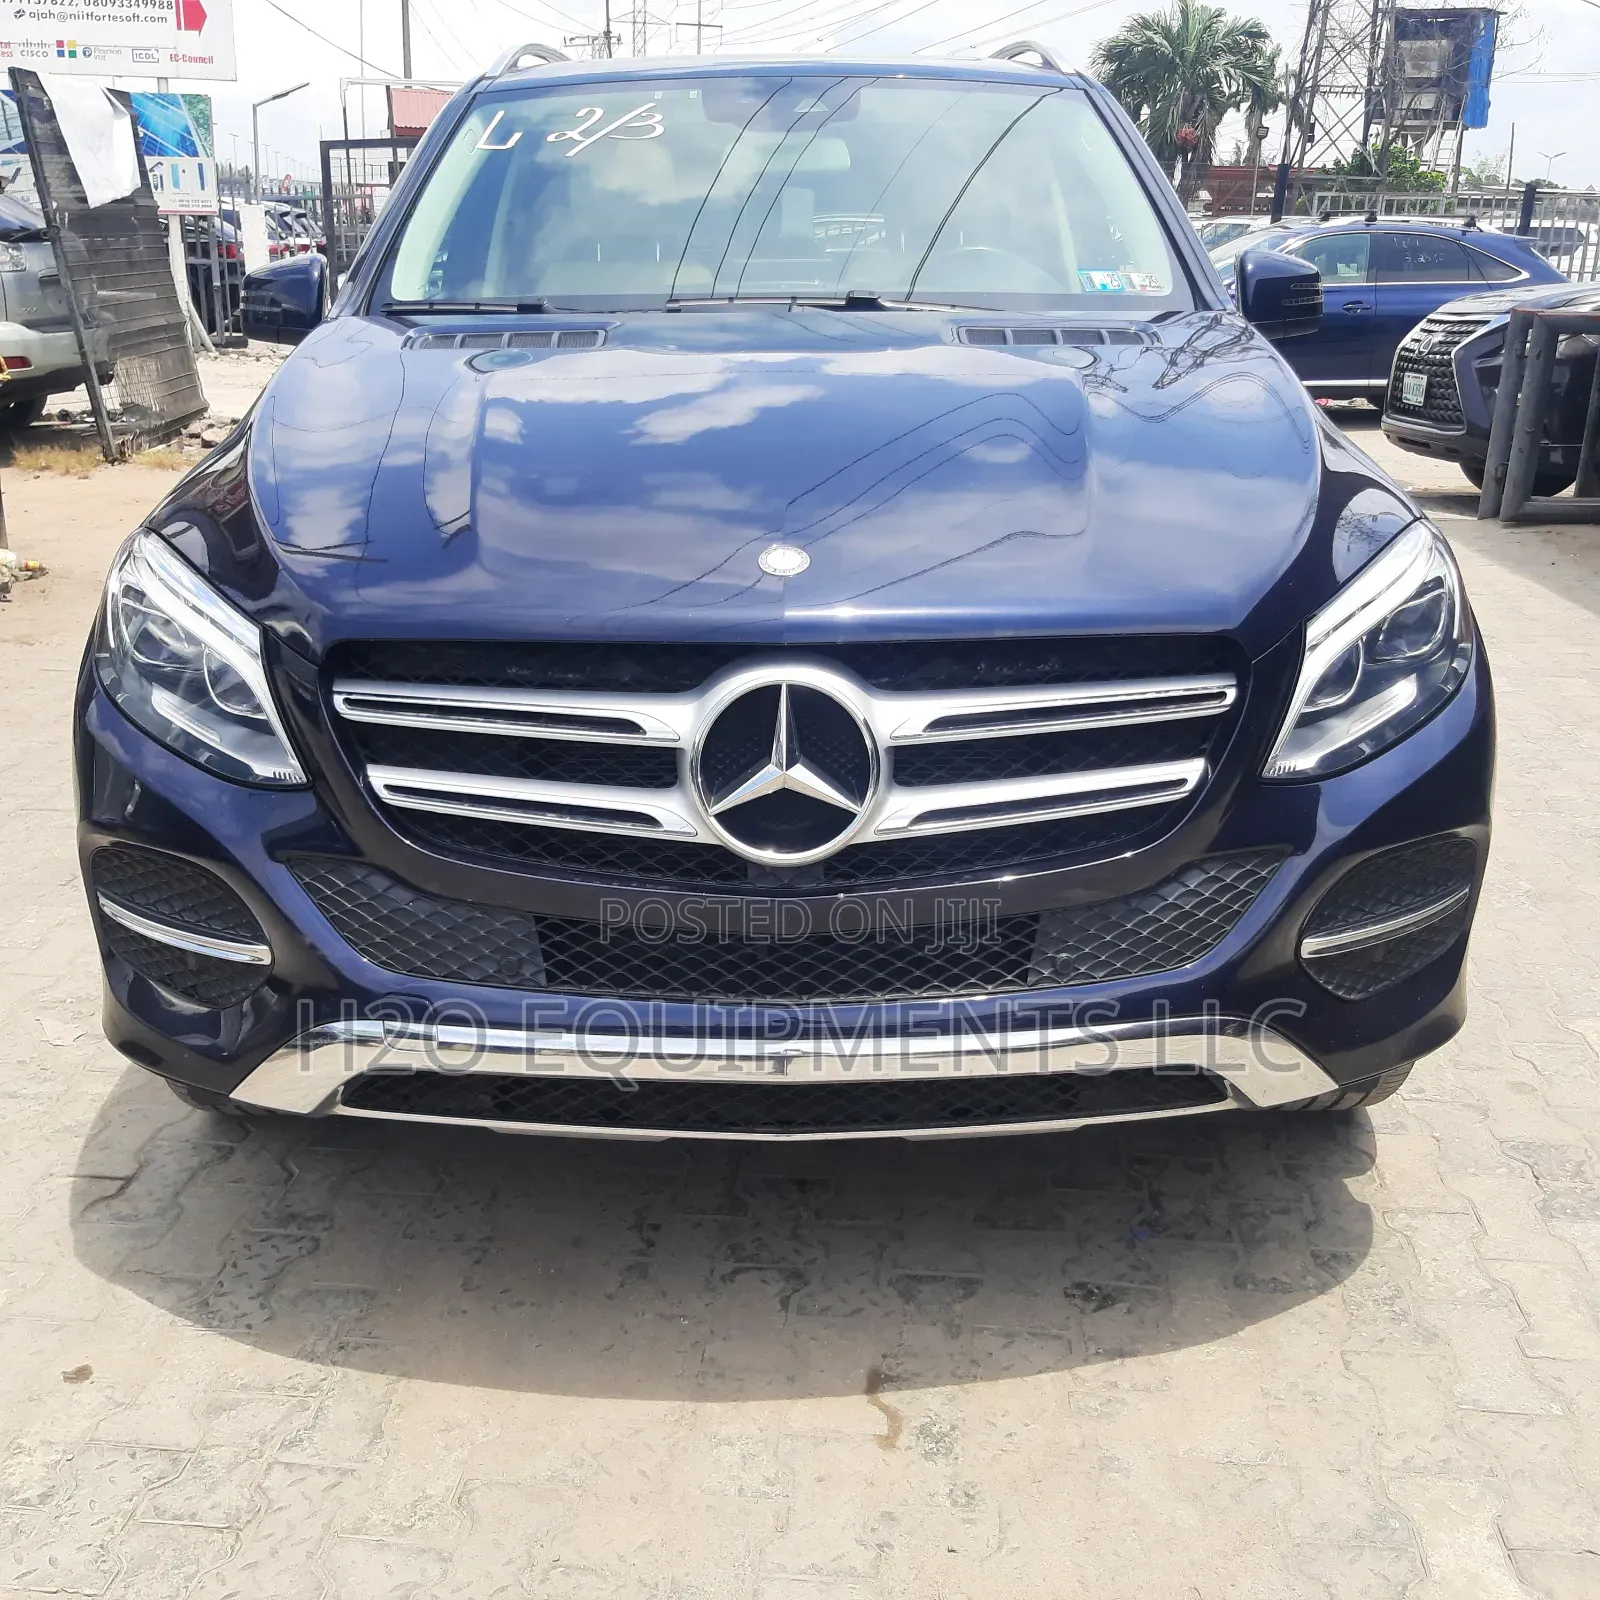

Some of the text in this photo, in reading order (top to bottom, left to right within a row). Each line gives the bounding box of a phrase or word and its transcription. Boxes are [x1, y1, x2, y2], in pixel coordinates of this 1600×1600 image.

[29, 9, 168, 23] ajah@niitfortesoft.com
[20, 50, 48, 58] CISCO
[169, 53, 214, 64] EC-Council
